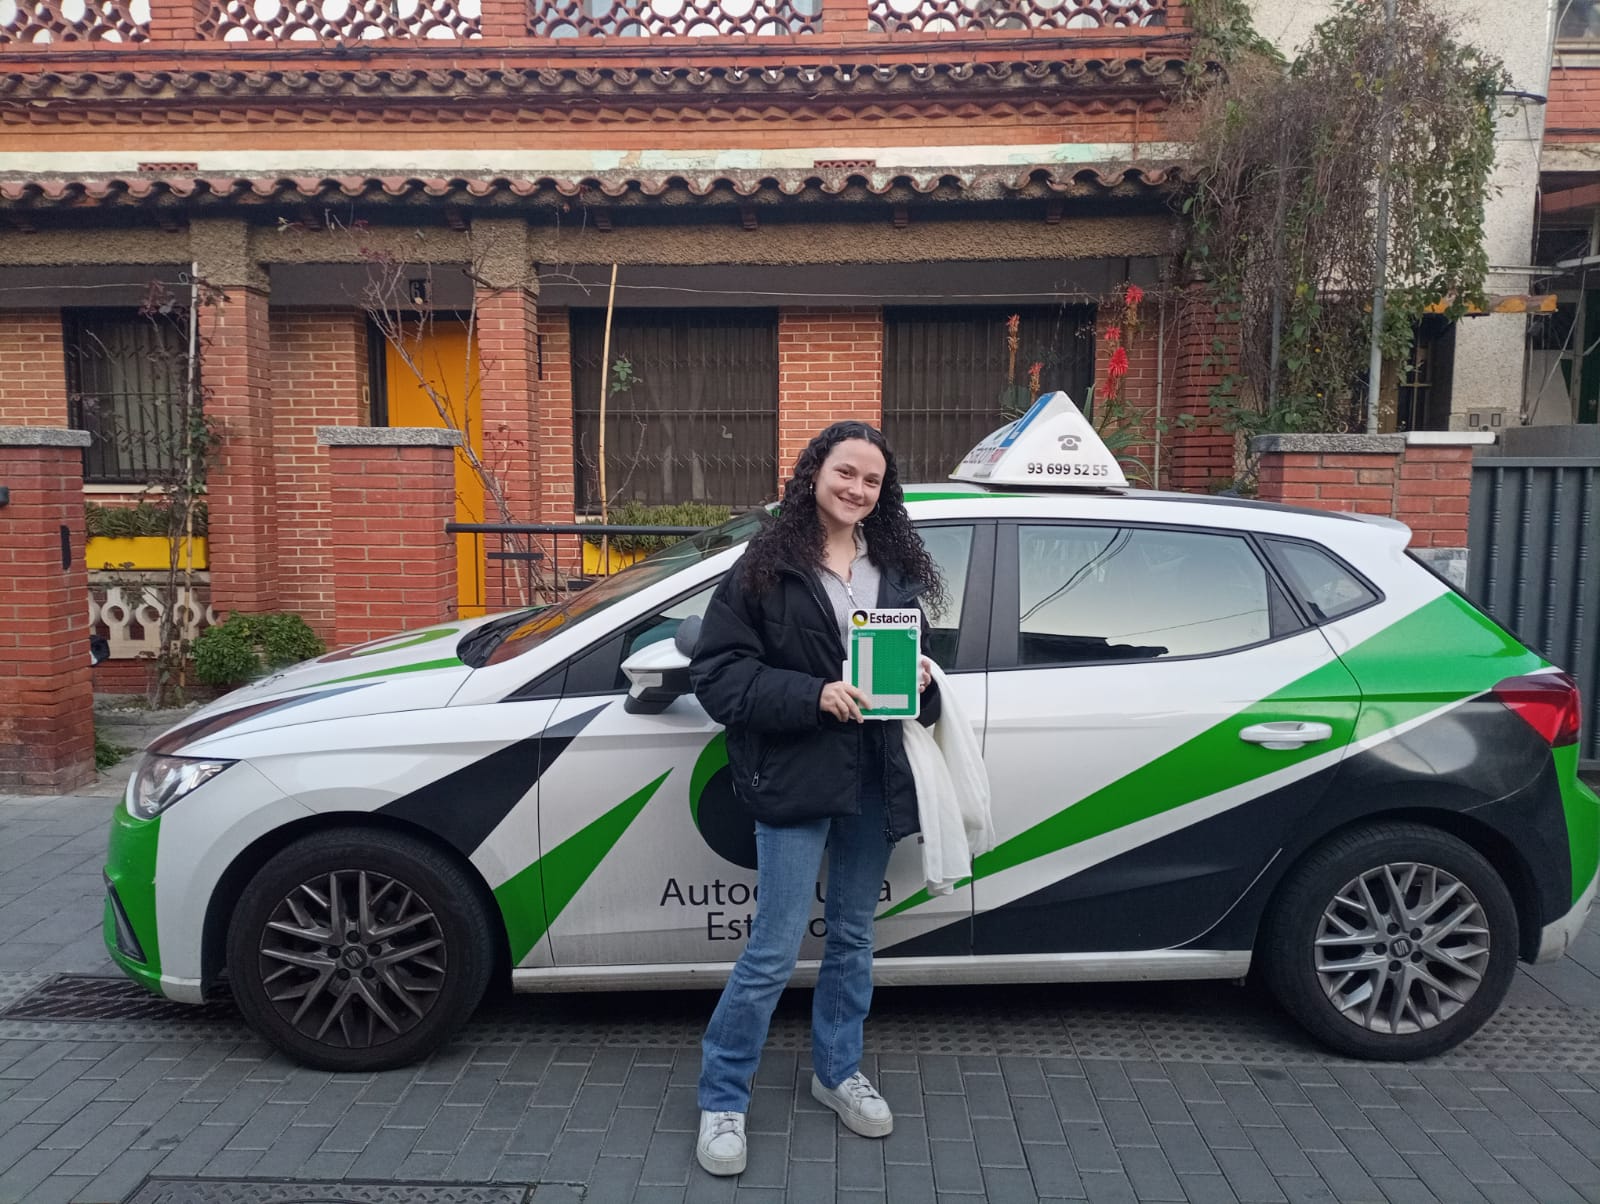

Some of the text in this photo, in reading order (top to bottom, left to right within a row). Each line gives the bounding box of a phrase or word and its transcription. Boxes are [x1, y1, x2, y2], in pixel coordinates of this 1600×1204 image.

[1027, 462, 1109, 476] 93 699 52 55
[870, 612, 917, 624] Estacion
[858, 637, 908, 709] L
